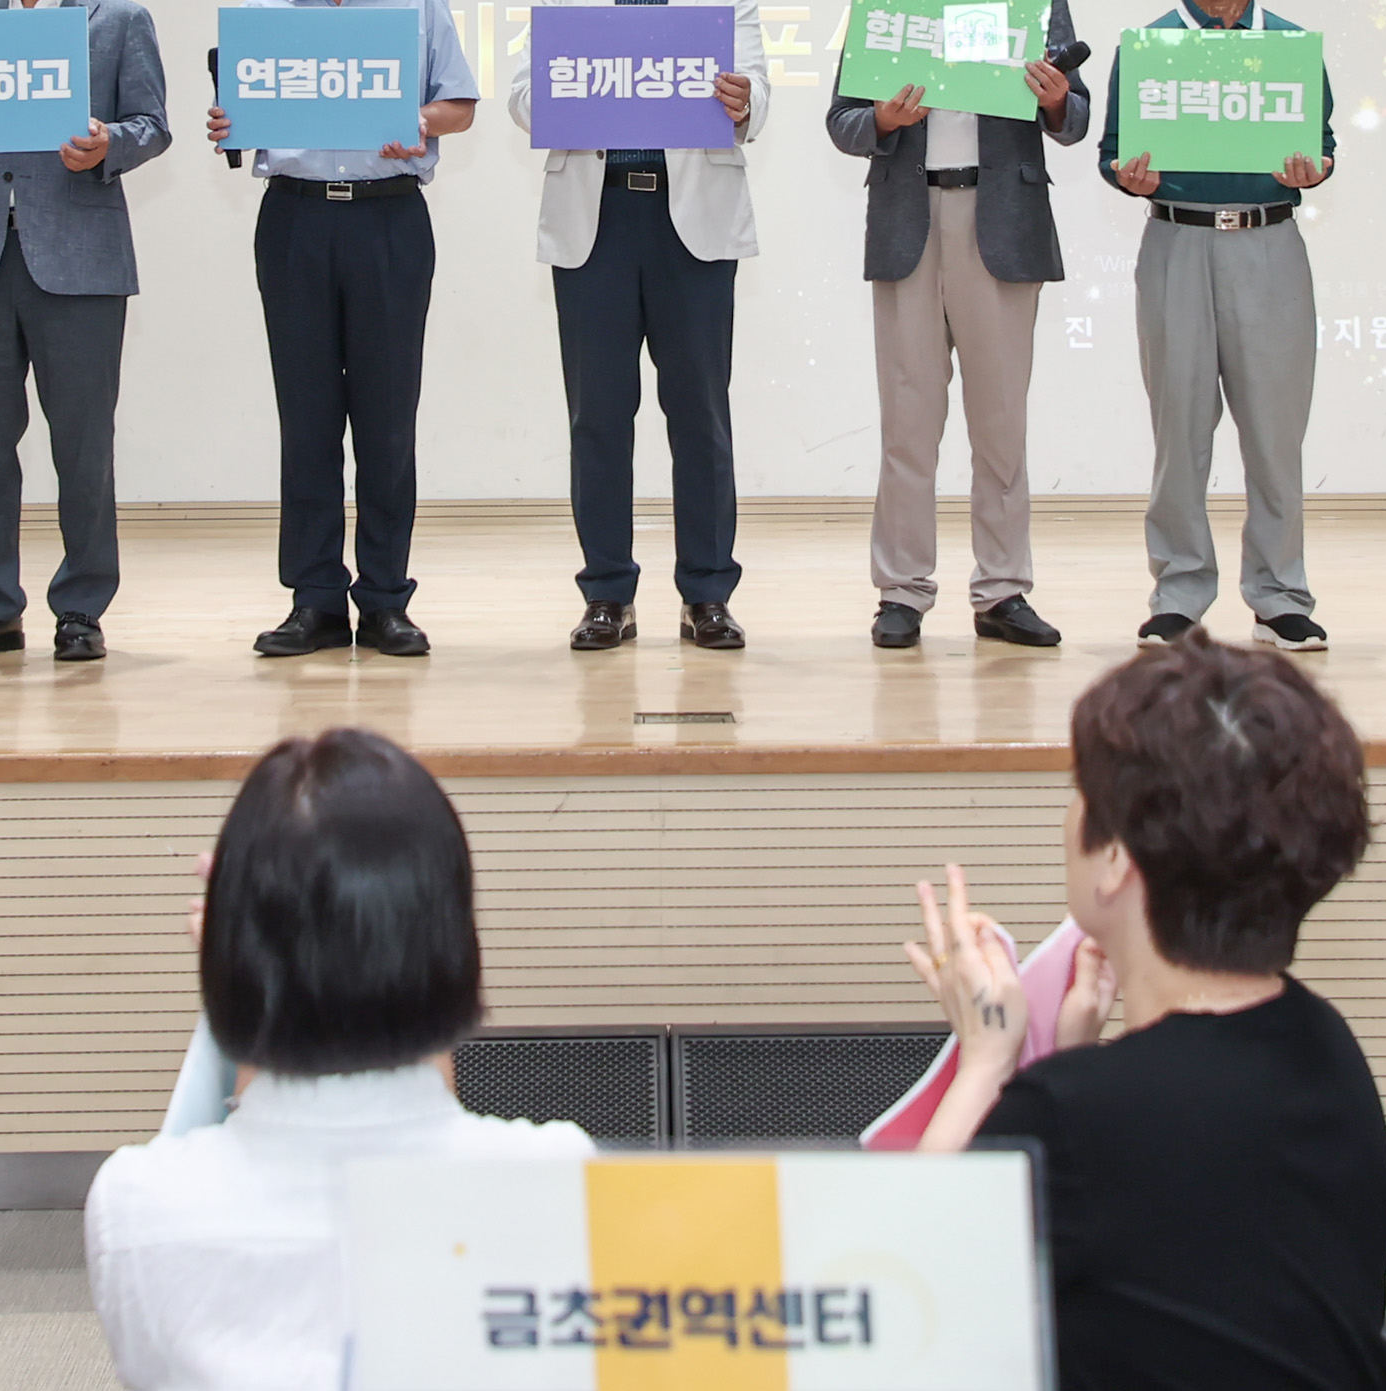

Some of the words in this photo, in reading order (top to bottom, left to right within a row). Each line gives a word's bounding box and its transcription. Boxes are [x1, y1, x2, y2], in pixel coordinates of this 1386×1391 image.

[235, 57, 402, 100] 연결하고
[548, 56, 720, 100] 함께성장
[1137, 78, 1305, 123] 협력하고
[481, 1285, 875, 1352] 금초권역센터
